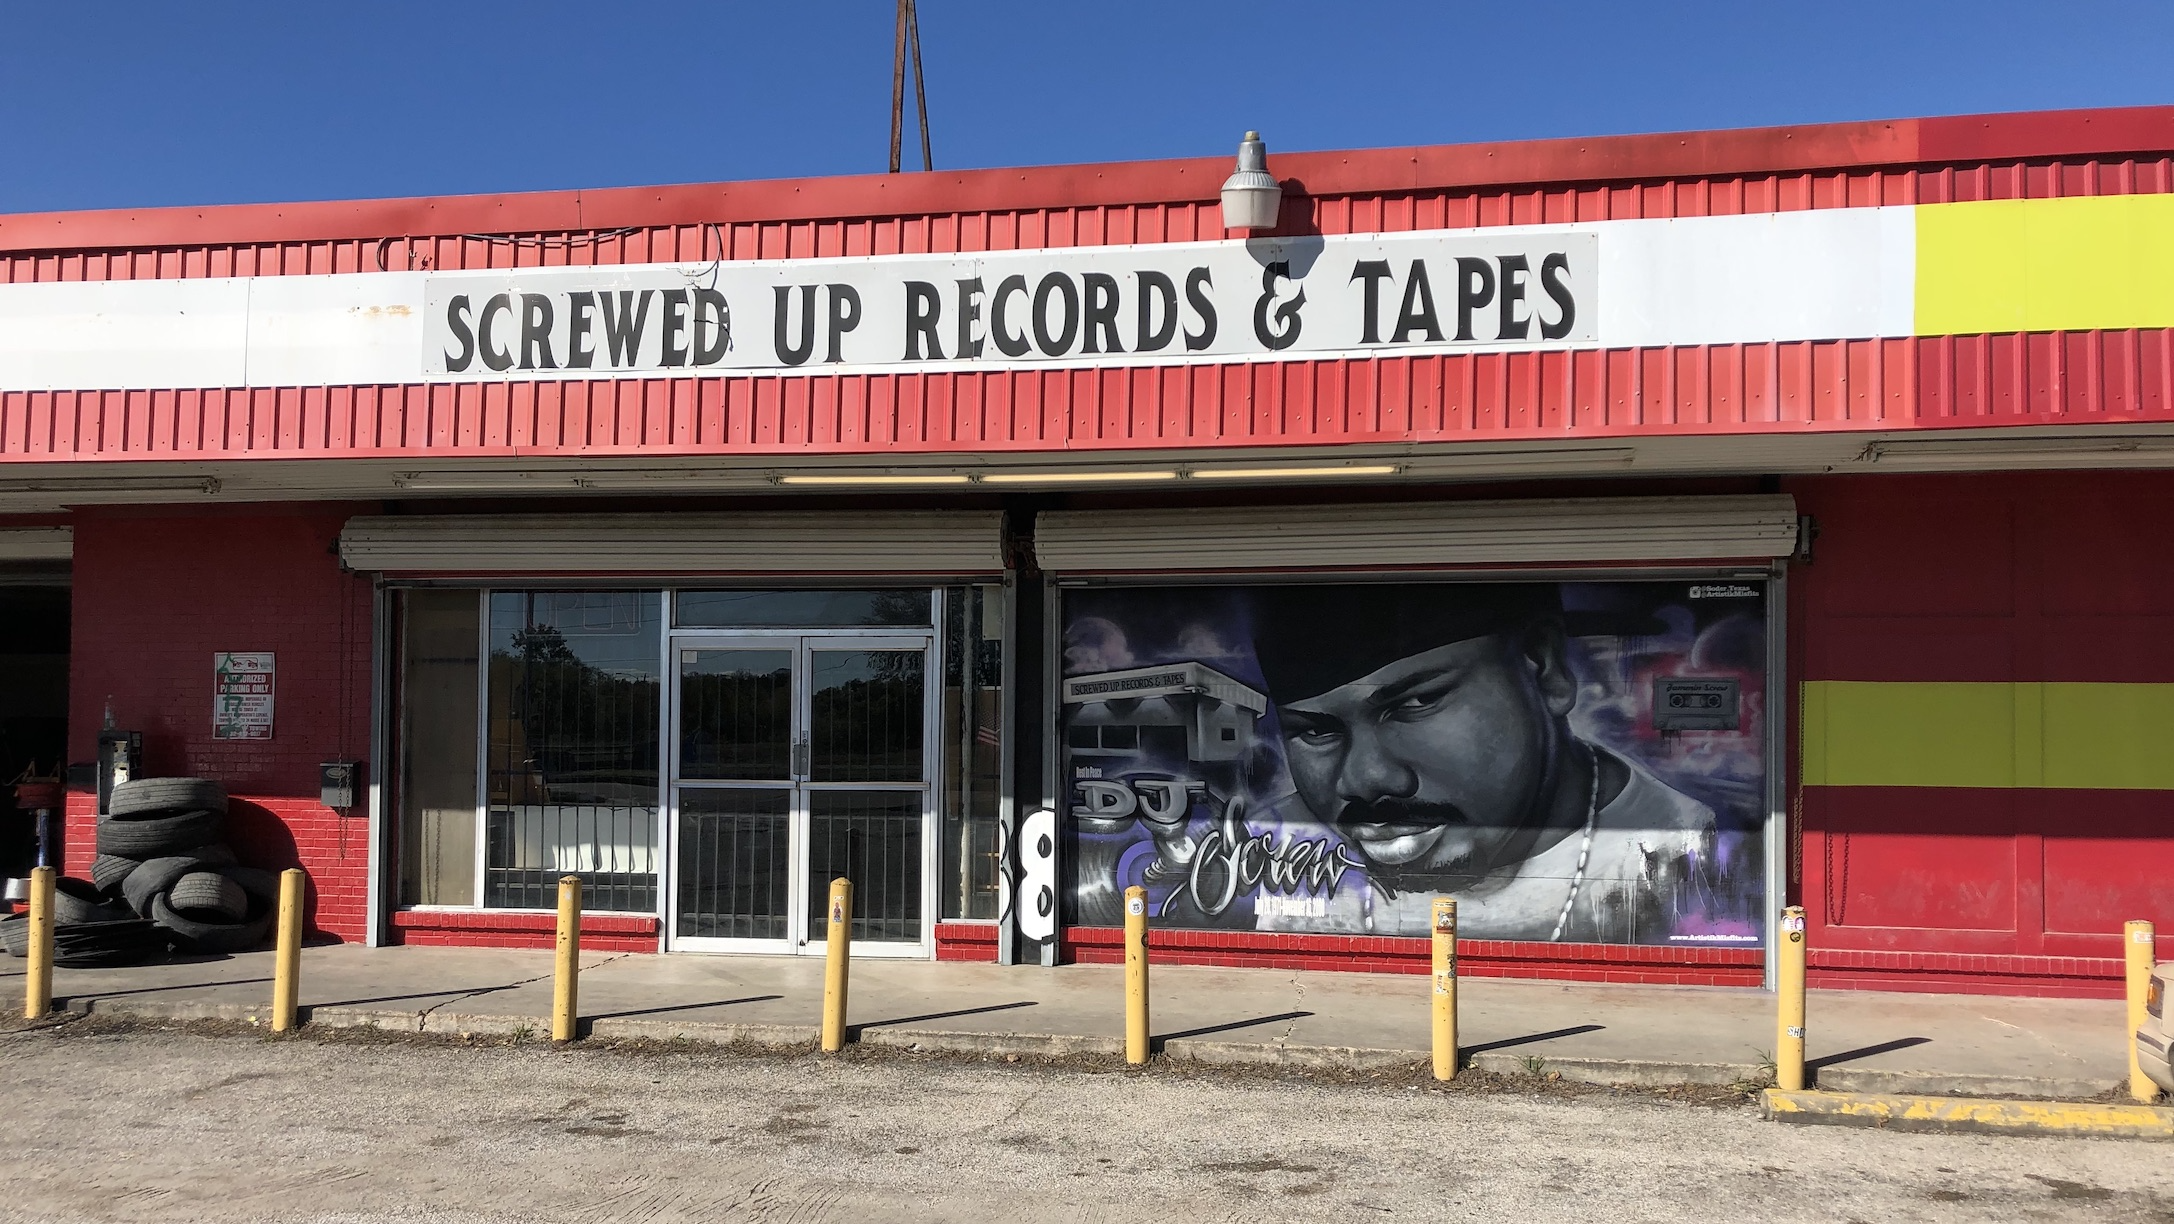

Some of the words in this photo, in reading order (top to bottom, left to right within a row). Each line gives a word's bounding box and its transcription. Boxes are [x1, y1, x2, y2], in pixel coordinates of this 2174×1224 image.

[443, 287, 731, 374] SCREWED
[771, 283, 862, 366] UP
[902, 264, 1219, 361] RECORDS
[1253, 259, 1309, 351] &
[1349, 252, 1579, 345] TAPES
[252, 684, 270, 693] ONLY
[1075, 683, 1109, 695] SCREWED
[1110, 682, 1120, 692] UP
[1121, 678, 1154, 690] RECORDS
[1154, 678, 1161, 687] &
[1163, 673, 1185, 685] TAPES
[1072, 779, 1206, 824] DJ
[1165, 795, 1373, 916] Screw
